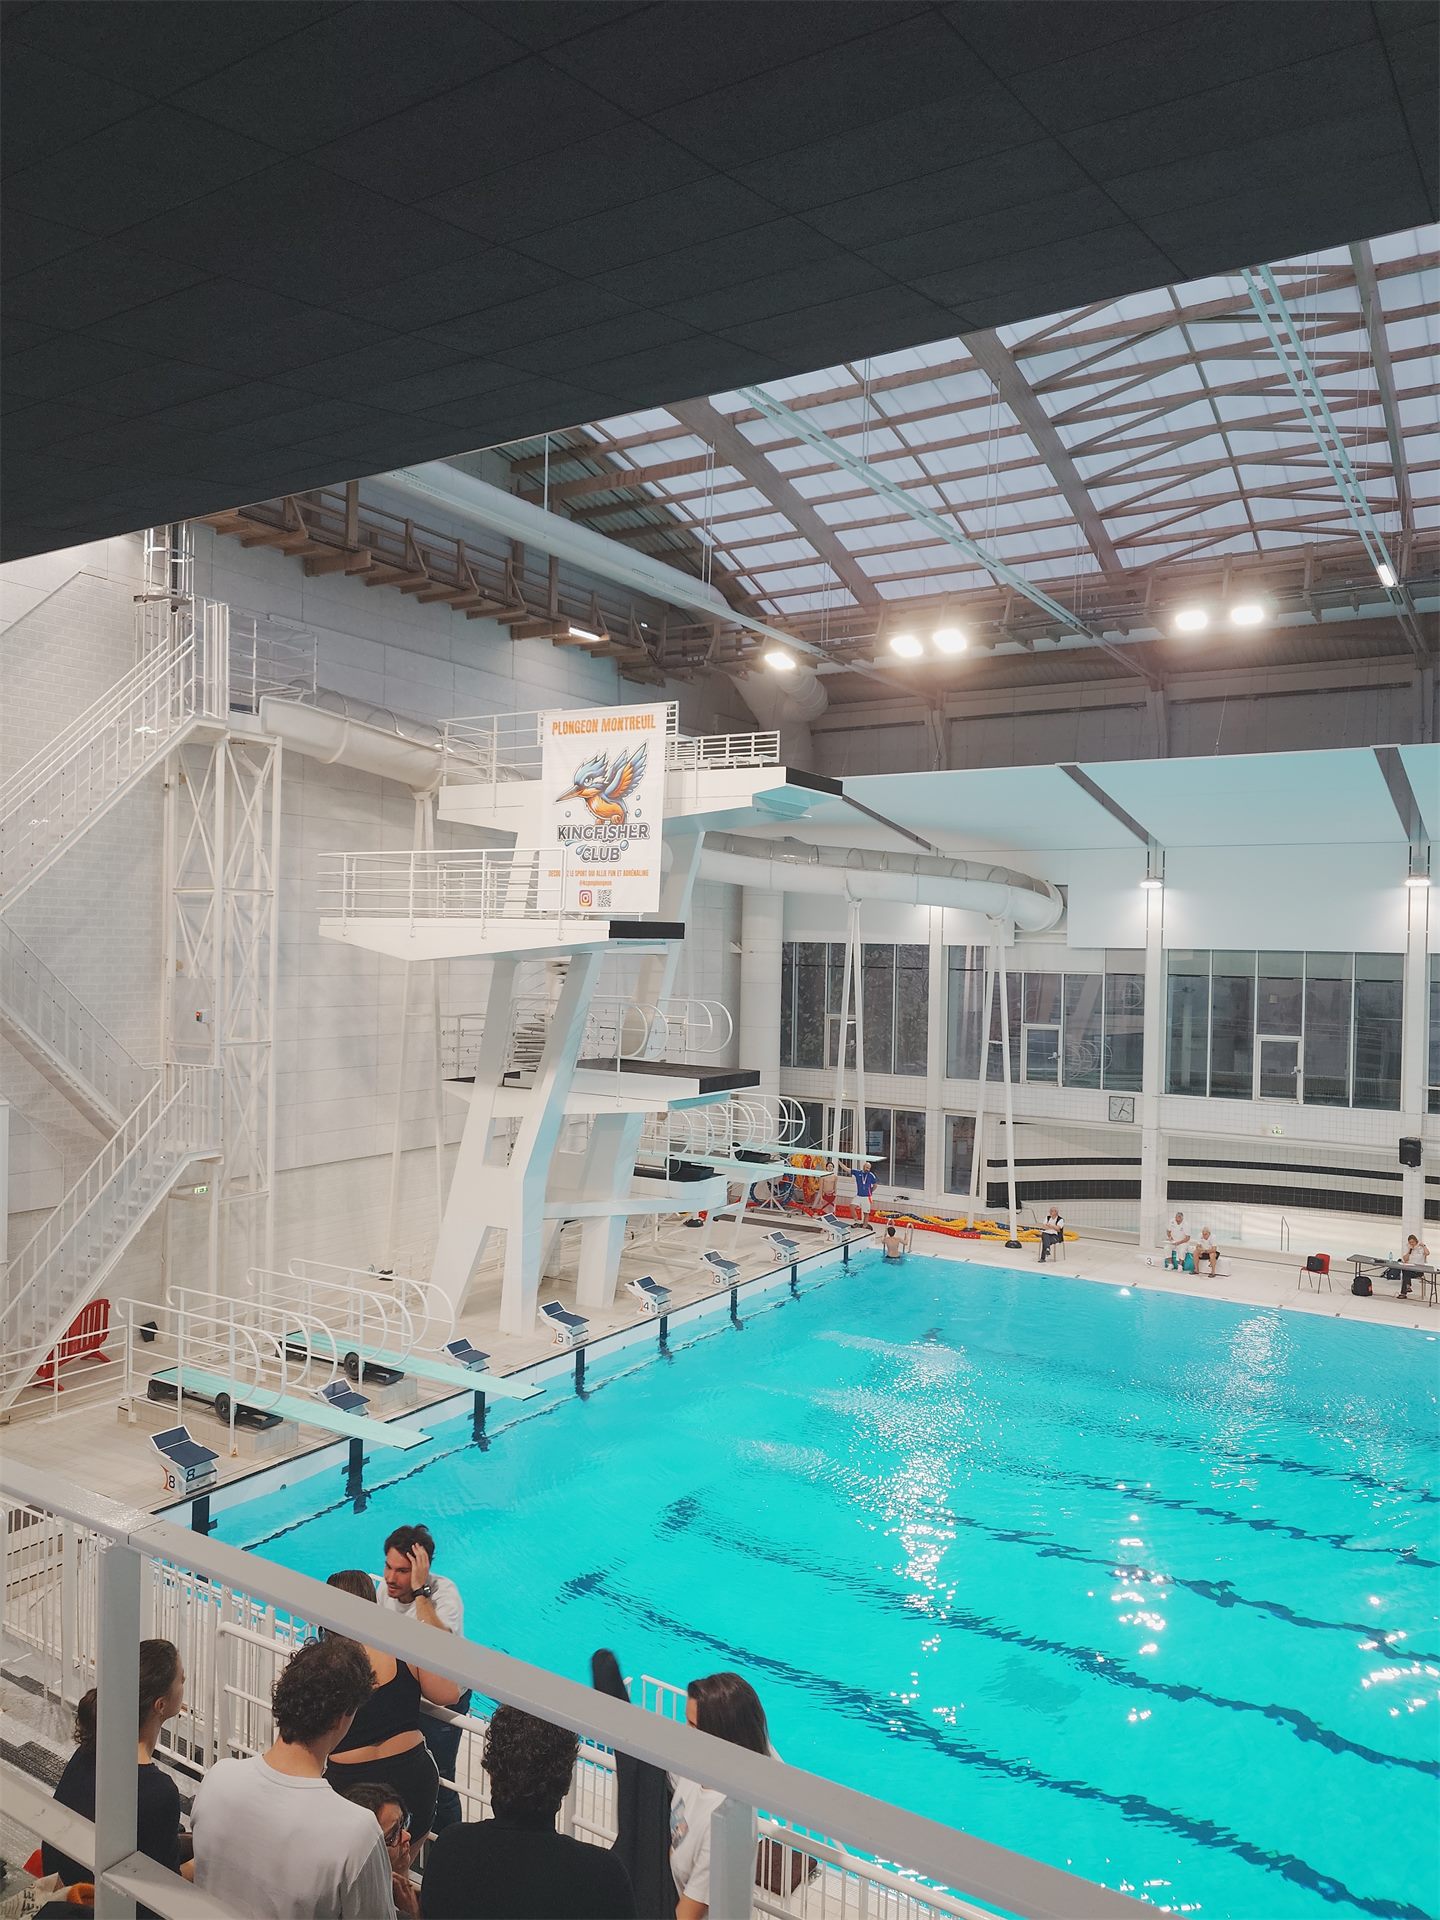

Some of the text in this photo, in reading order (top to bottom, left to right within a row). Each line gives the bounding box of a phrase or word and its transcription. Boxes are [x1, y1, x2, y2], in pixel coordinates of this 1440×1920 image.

[552, 714, 656, 736] PLONGEON MONTREUIL
[558, 823, 649, 841] KINGFISHER
[581, 847, 620, 861] CLUB
[776, 1252, 782, 1260] 2
[1146, 1257, 1152, 1265] 3
[715, 1274, 720, 1283] 3
[643, 1301, 649, 1310] 4
[557, 1333, 563, 1343] 5
[186, 1468, 195, 1482] 8
[168, 1475, 175, 1488] 8
